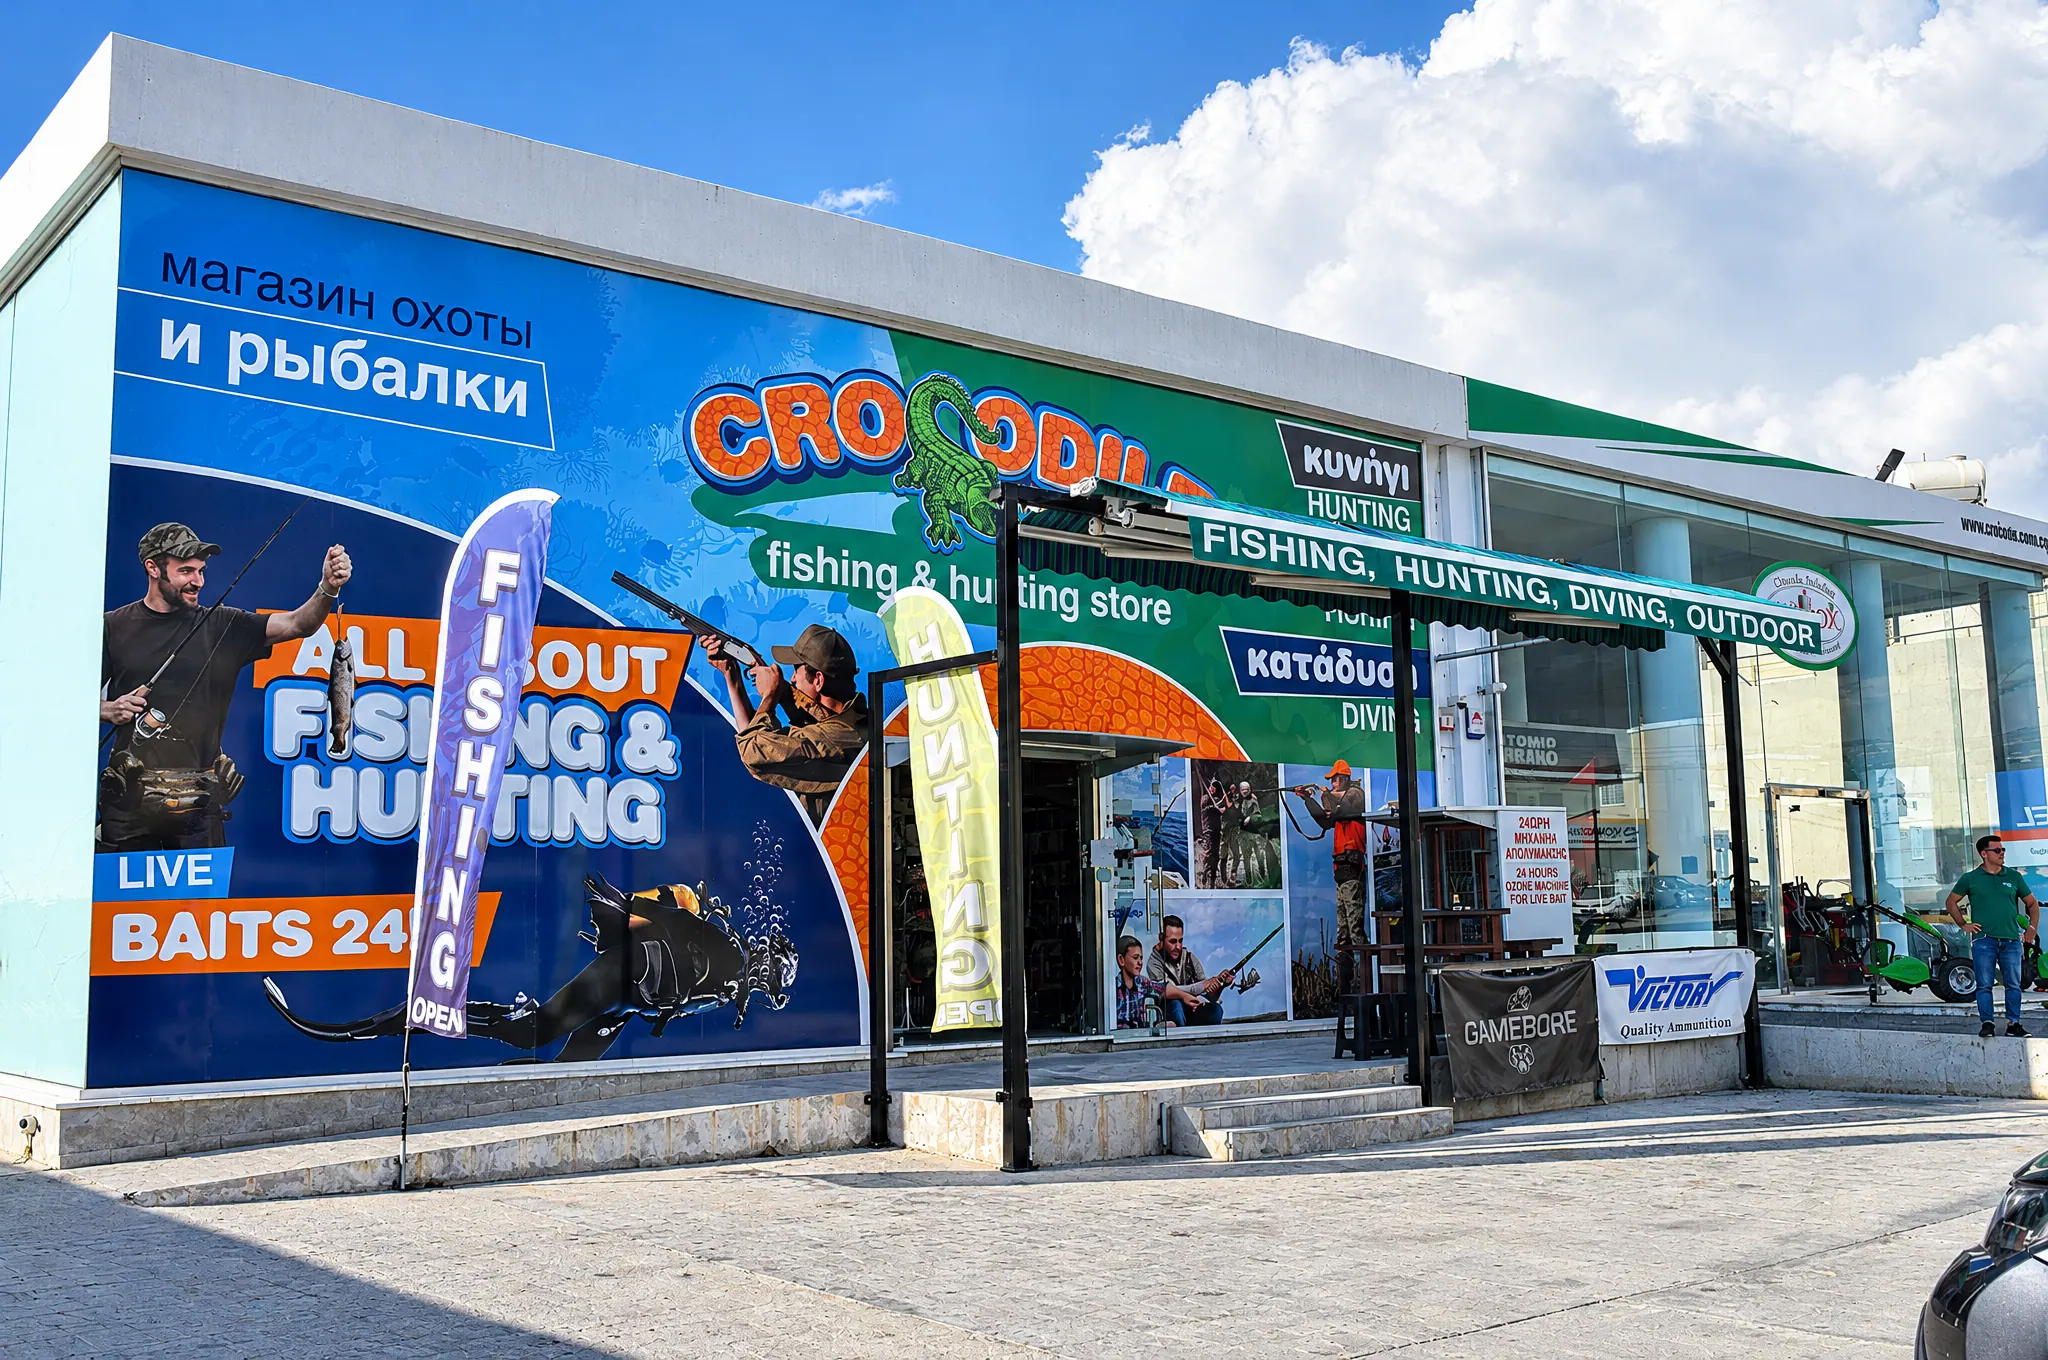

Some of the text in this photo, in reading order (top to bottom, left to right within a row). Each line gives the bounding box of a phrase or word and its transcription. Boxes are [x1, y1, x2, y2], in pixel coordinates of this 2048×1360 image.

[162, 252, 532, 349] магазин охоты
[160, 318, 528, 418] и рыбалки
[1307, 490, 1411, 532] HUNTING
[766, 540, 1172, 626] fishing & huting store
[1203, 522, 1376, 582] FISHING,
[1395, 554, 1559, 611] HUNTING,
[1568, 583, 1675, 629] DIVING,
[1685, 603, 1816, 648] OUTDOOR
[622, 708, 679, 776] &
[429, 548, 522, 990] FISHING
[290, 764, 664, 845] HUTING
[119, 853, 213, 889] LIVE
[1505, 881, 1569, 892] OZONE MACHINE
[1516, 867, 1559, 878] 24 HOURS
[1510, 893, 1567, 905] FOR LIVE BAIT
[112, 909, 314, 963] BAITS
[411, 996, 463, 1033] OPEN
[1464, 1009, 1578, 1046] GAMEBORE
[1620, 1017, 1732, 1039] Quality Ammunition
